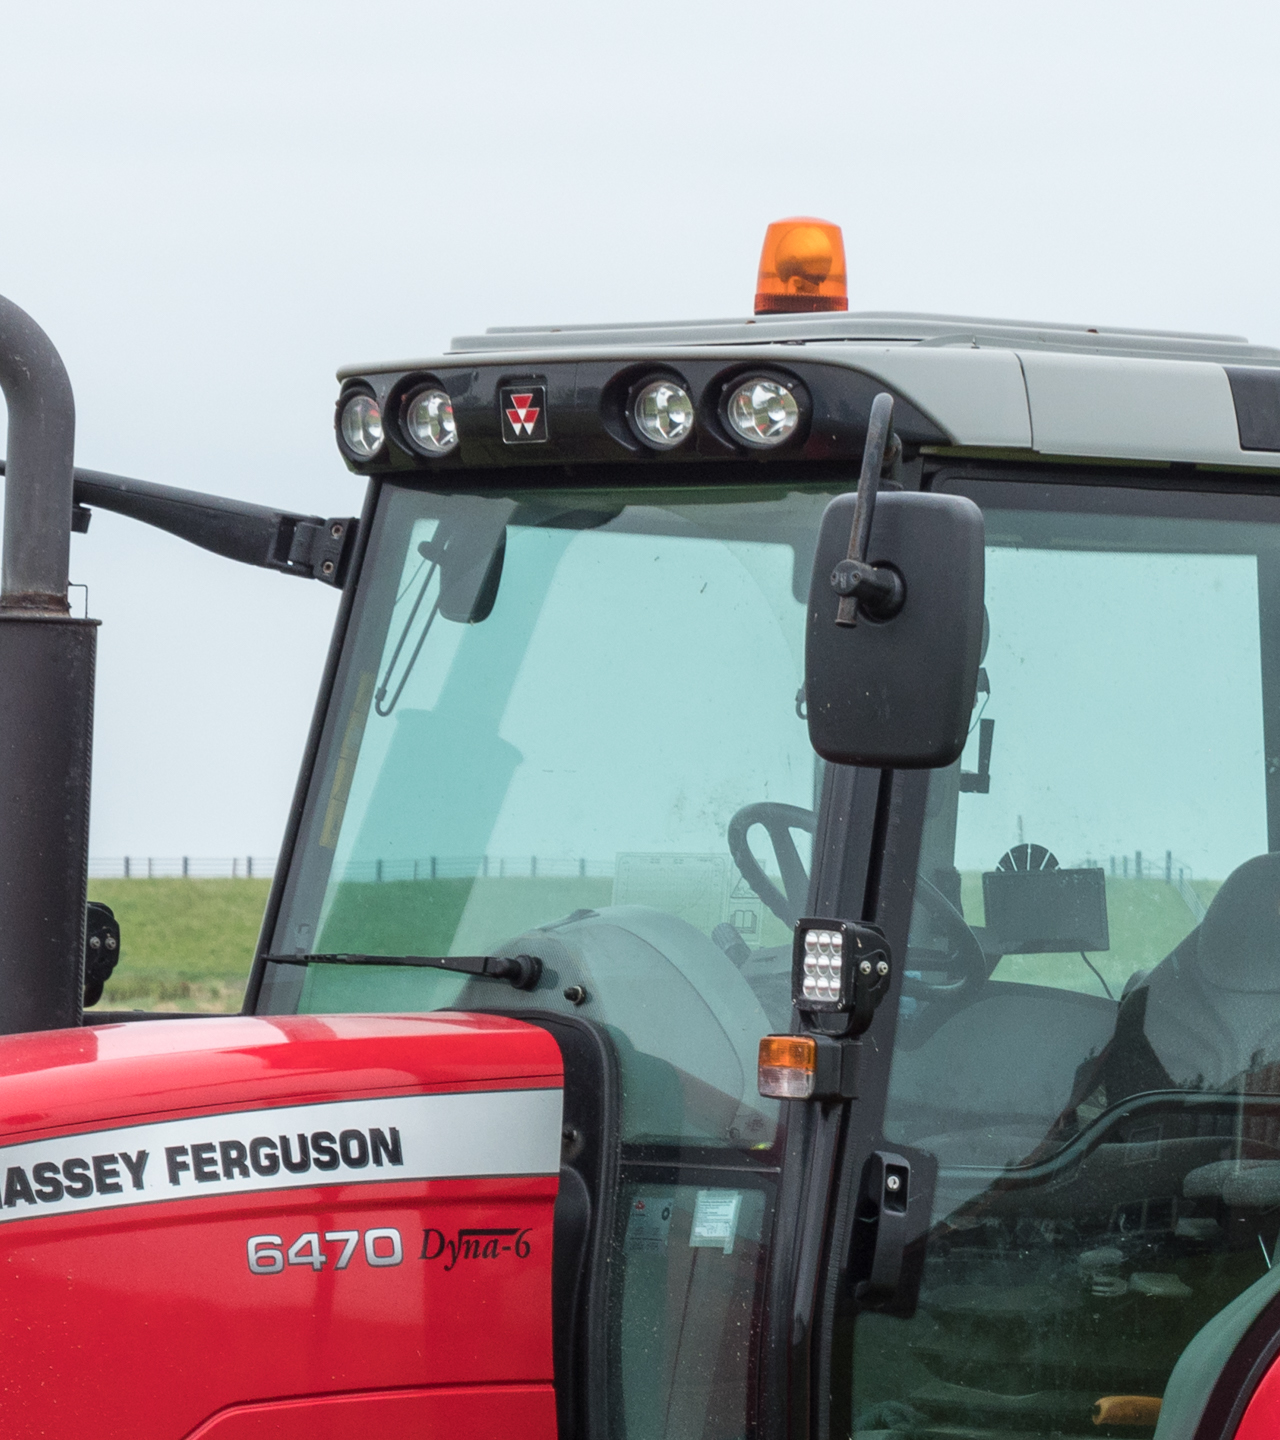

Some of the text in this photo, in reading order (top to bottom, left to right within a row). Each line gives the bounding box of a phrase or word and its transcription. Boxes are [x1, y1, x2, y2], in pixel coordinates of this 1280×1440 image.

[164, 1127, 404, 1186] FERGUSON
[247, 1226, 532, 1275] 6470 Dyna-6
